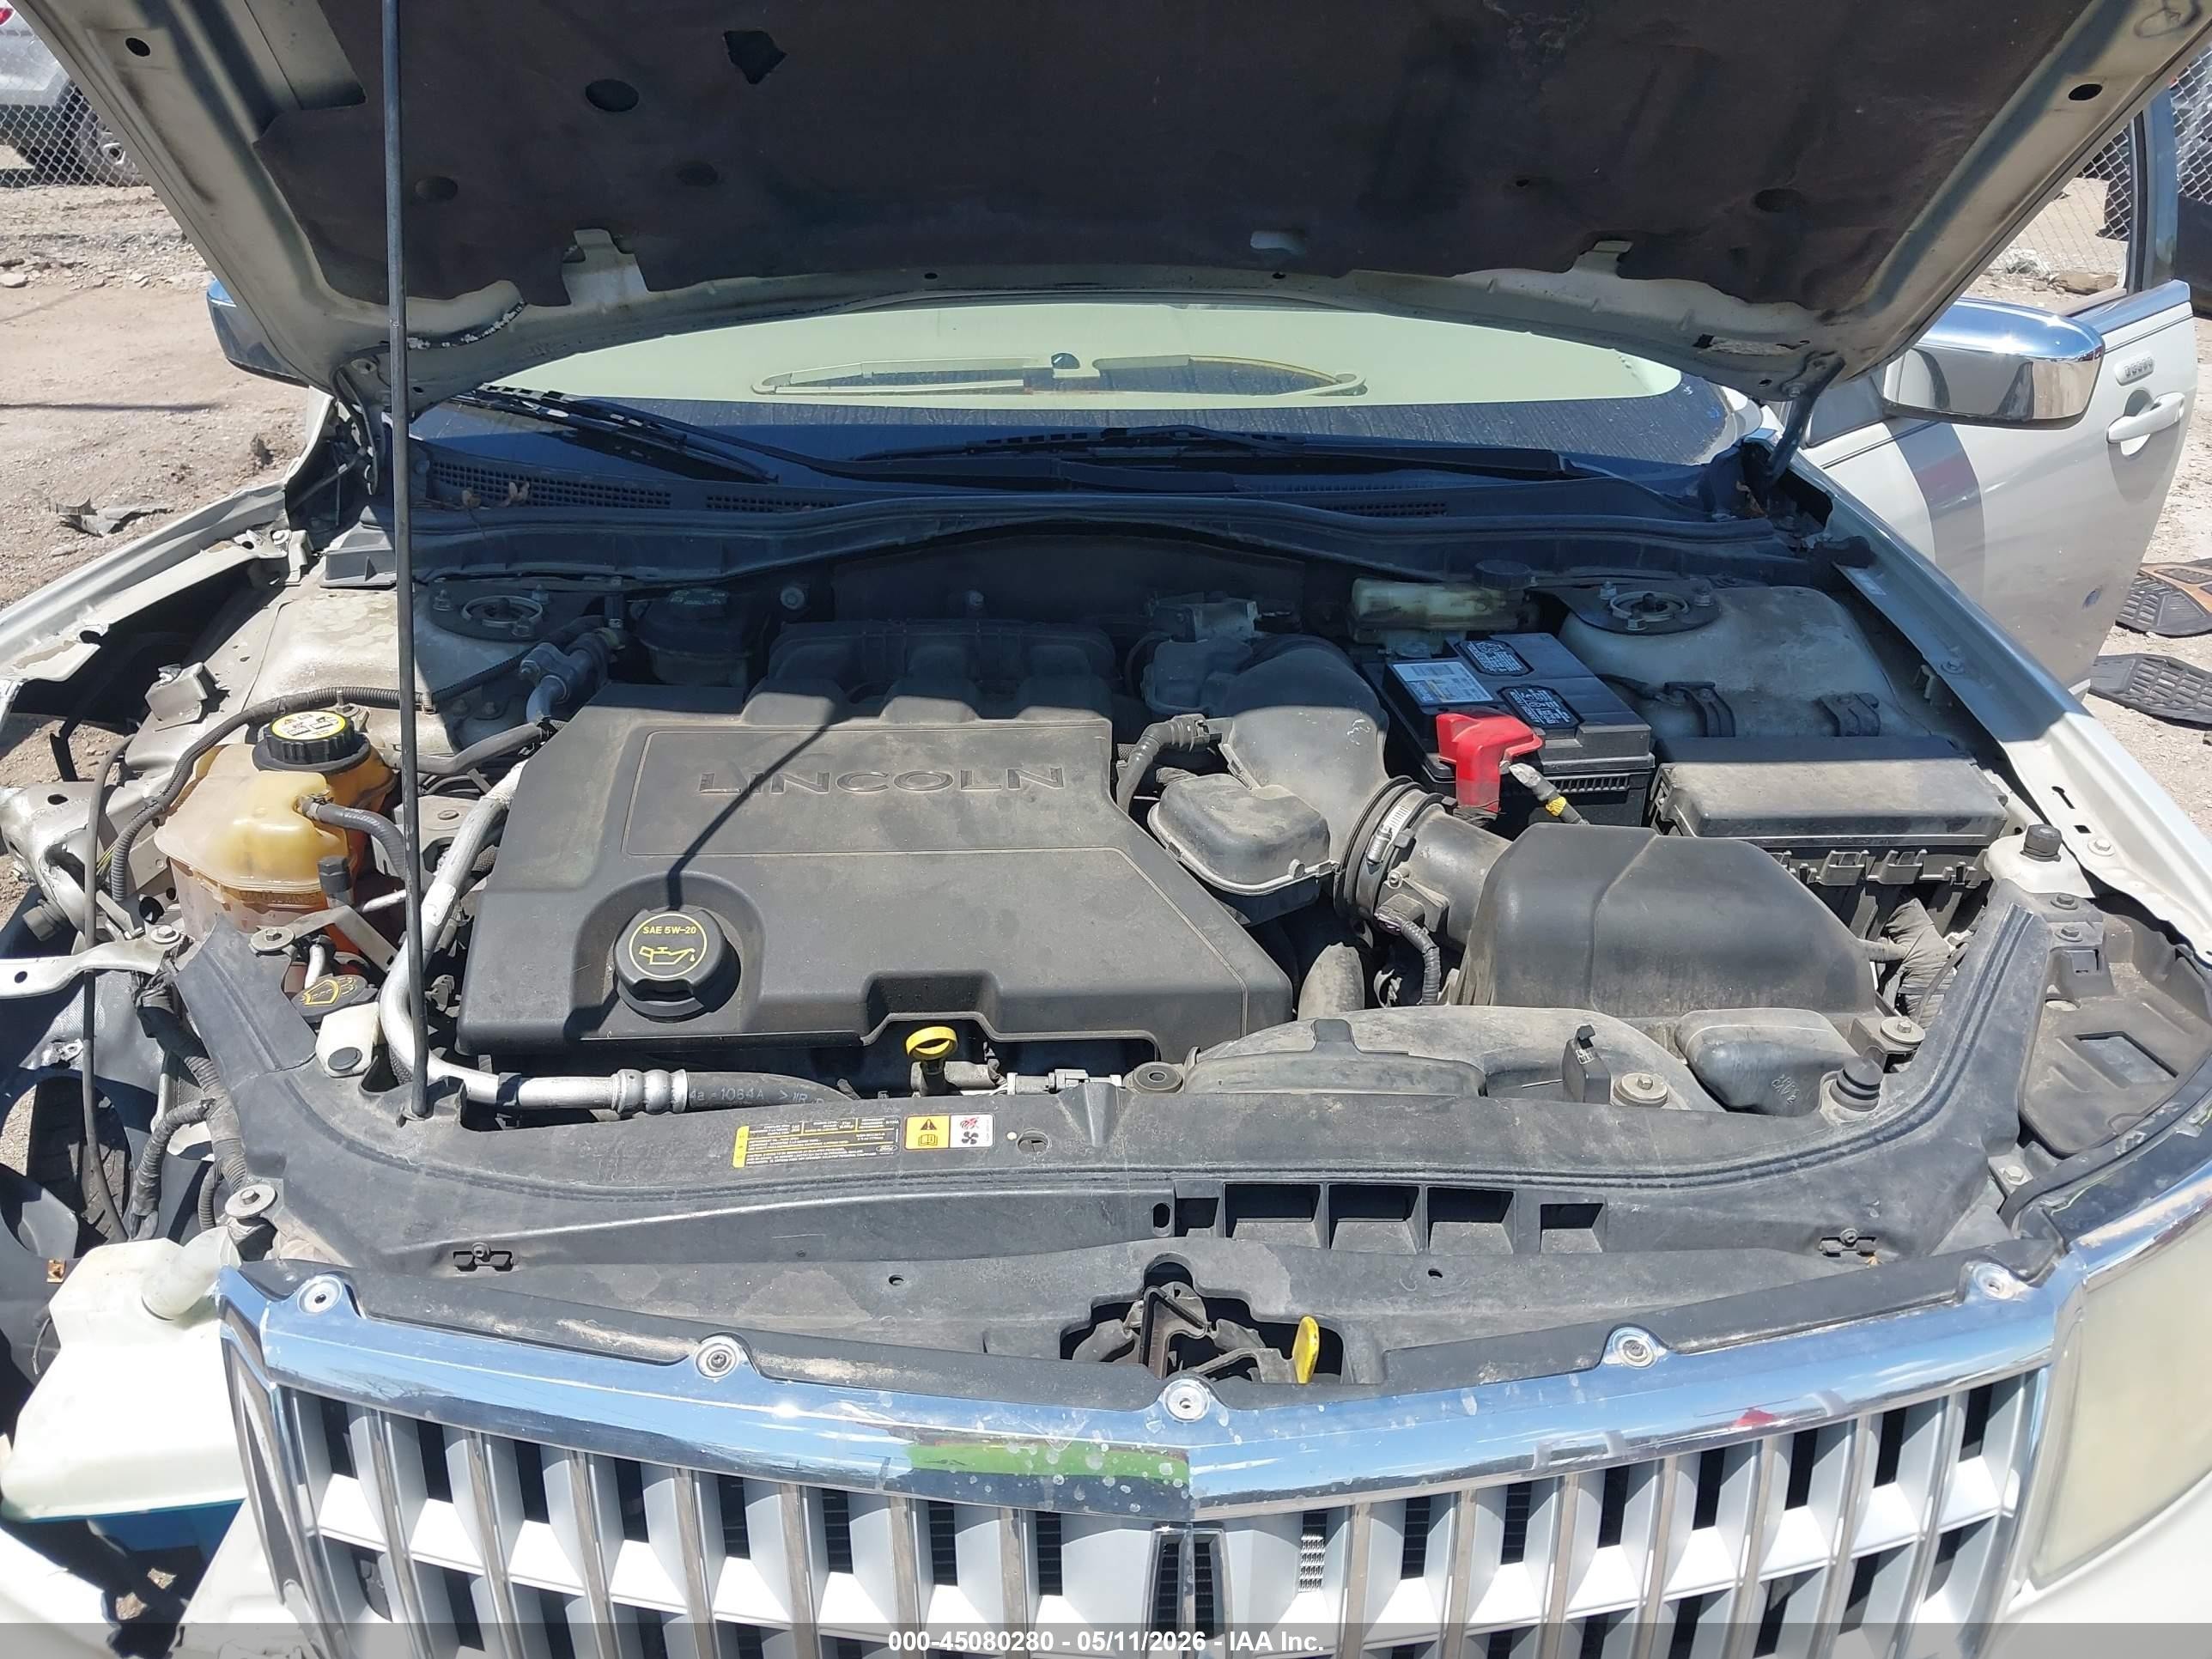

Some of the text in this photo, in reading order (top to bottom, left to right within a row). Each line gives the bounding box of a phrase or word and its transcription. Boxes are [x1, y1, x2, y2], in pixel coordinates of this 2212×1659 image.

[697, 766, 1065, 795] LINCOLN
[642, 926, 696, 934] SAE 5W-20
